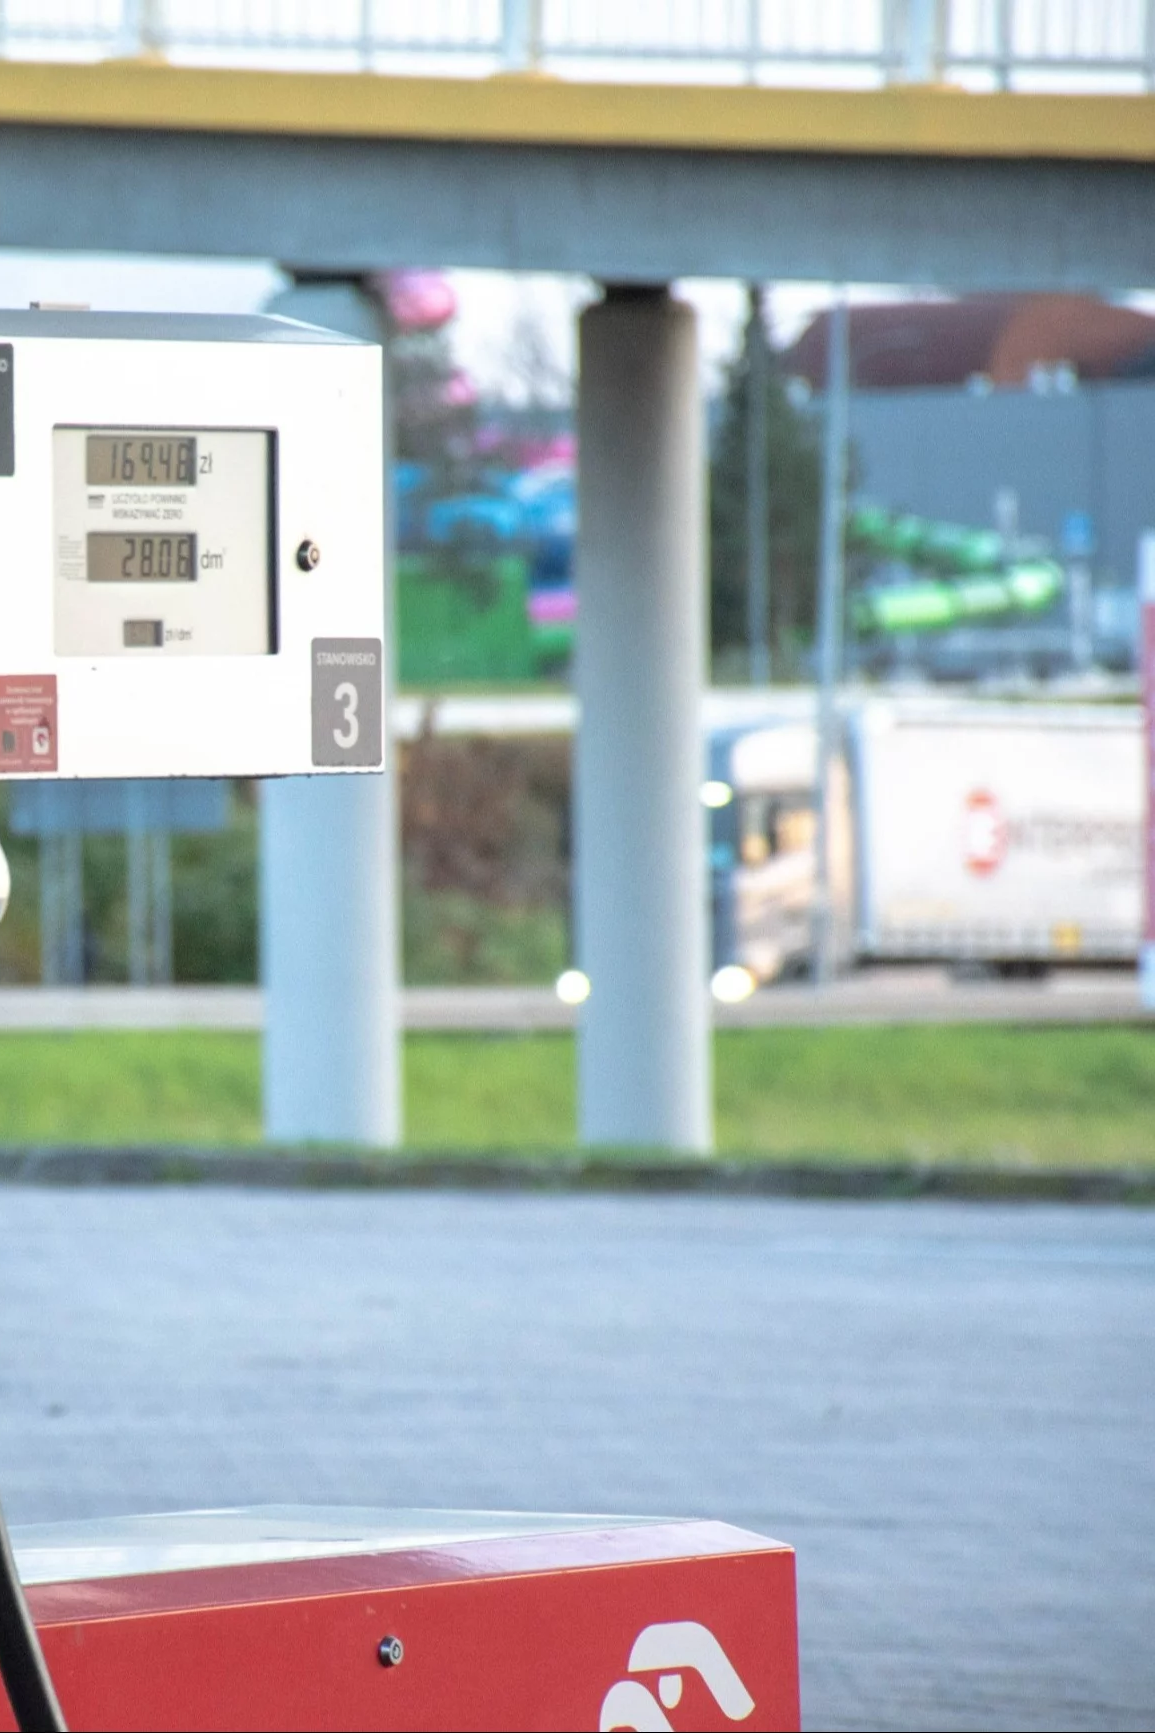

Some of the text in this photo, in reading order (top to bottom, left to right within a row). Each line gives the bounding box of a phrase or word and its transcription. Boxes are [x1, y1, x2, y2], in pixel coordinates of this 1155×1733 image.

[199, 453, 213, 474] zł
[316, 652, 376, 666] STANOWISKO
[333, 682, 359, 749] 3
